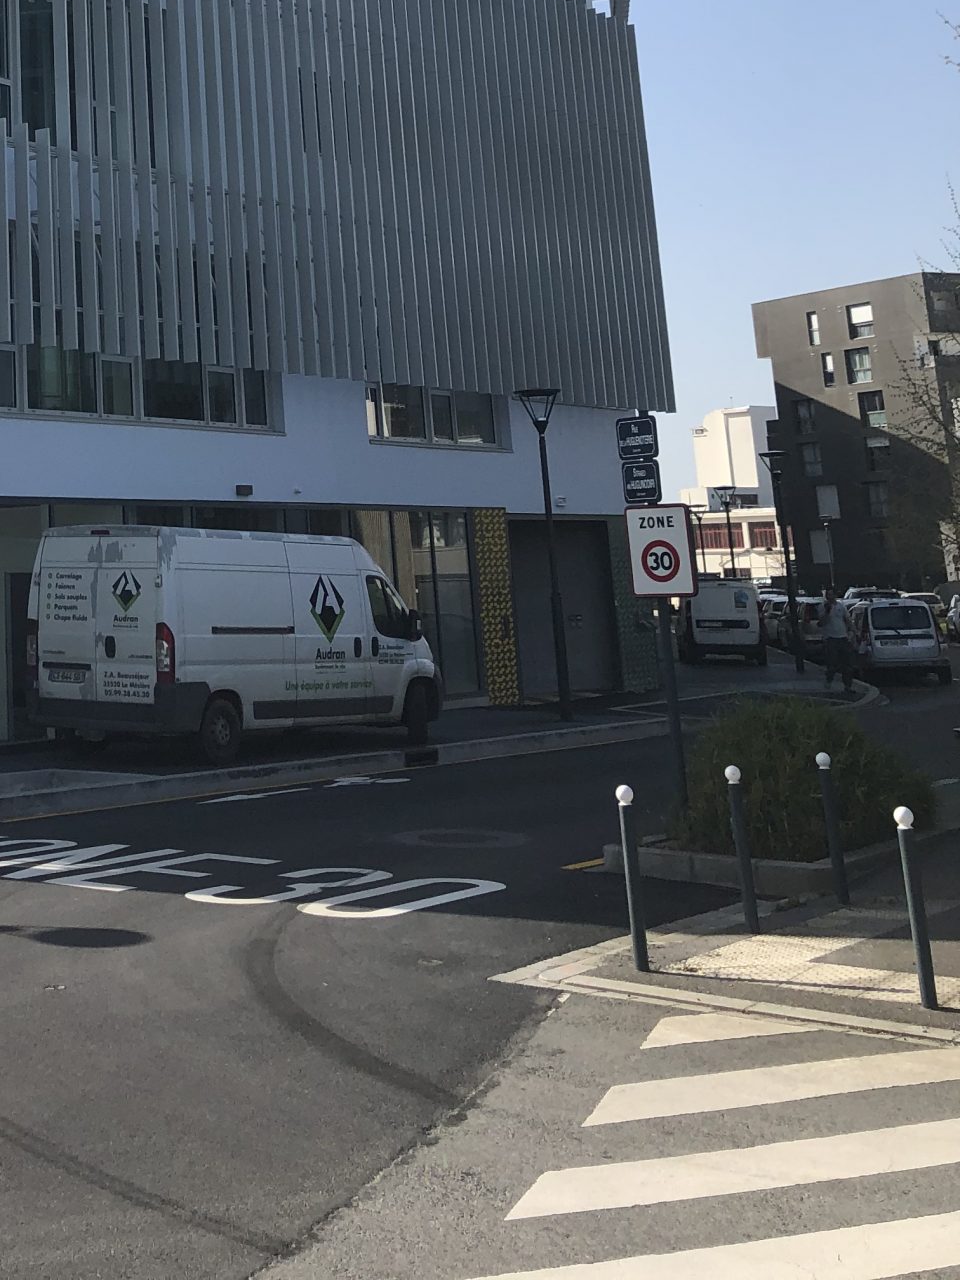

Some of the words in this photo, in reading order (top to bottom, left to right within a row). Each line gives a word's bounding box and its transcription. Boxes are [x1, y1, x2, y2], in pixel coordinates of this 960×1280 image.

[638, 515, 675, 529] ZONE
[648, 551, 673, 571] 30
[56, 572, 82, 581] Carrelage
[67, 593, 87, 602] souples
[54, 614, 71, 622] Chape
[316, 647, 346, 659] Audran
[285, 680, 298, 691] Une
[300, 680, 324, 693] équipe
[331, 680, 349, 689] votre
[184, 866, 507, 918] 30
